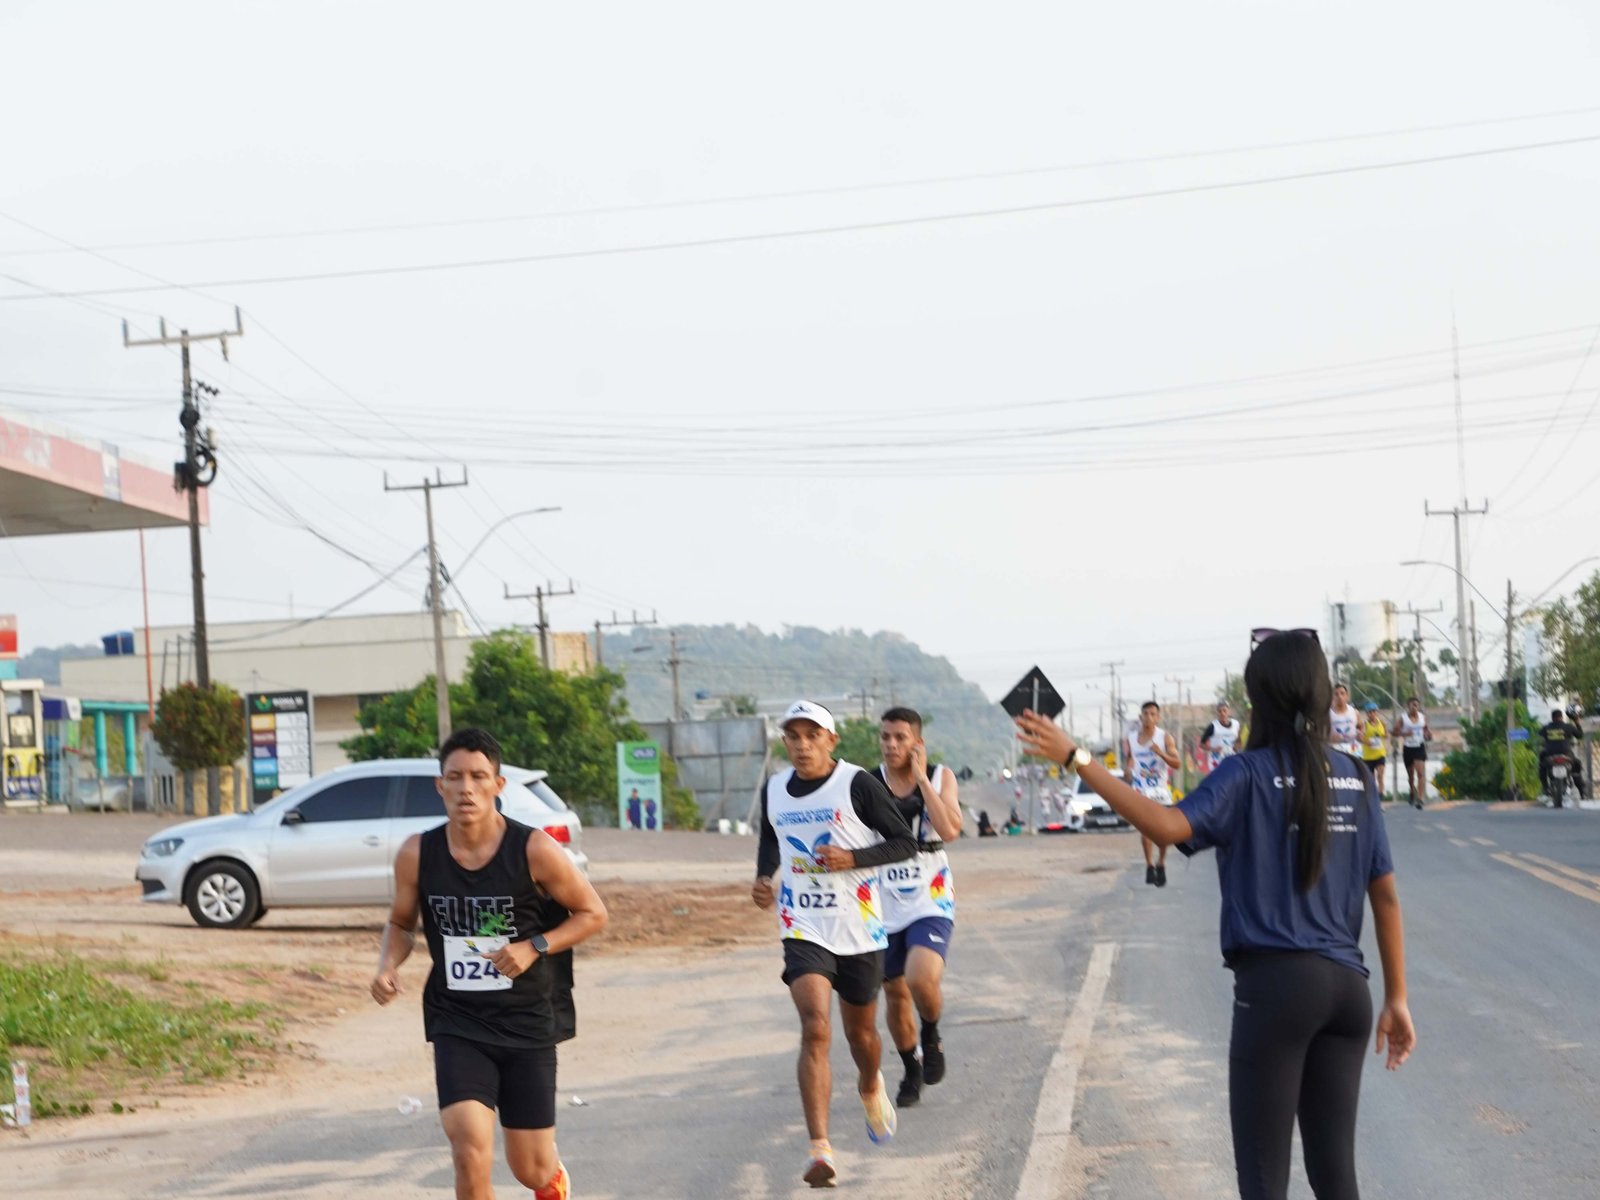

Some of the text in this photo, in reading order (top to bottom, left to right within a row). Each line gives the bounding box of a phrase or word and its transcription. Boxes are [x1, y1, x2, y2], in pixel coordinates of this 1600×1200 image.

[799, 893, 838, 909] 022
[428, 895, 518, 938] ELITE
[451, 961, 500, 980] 024
